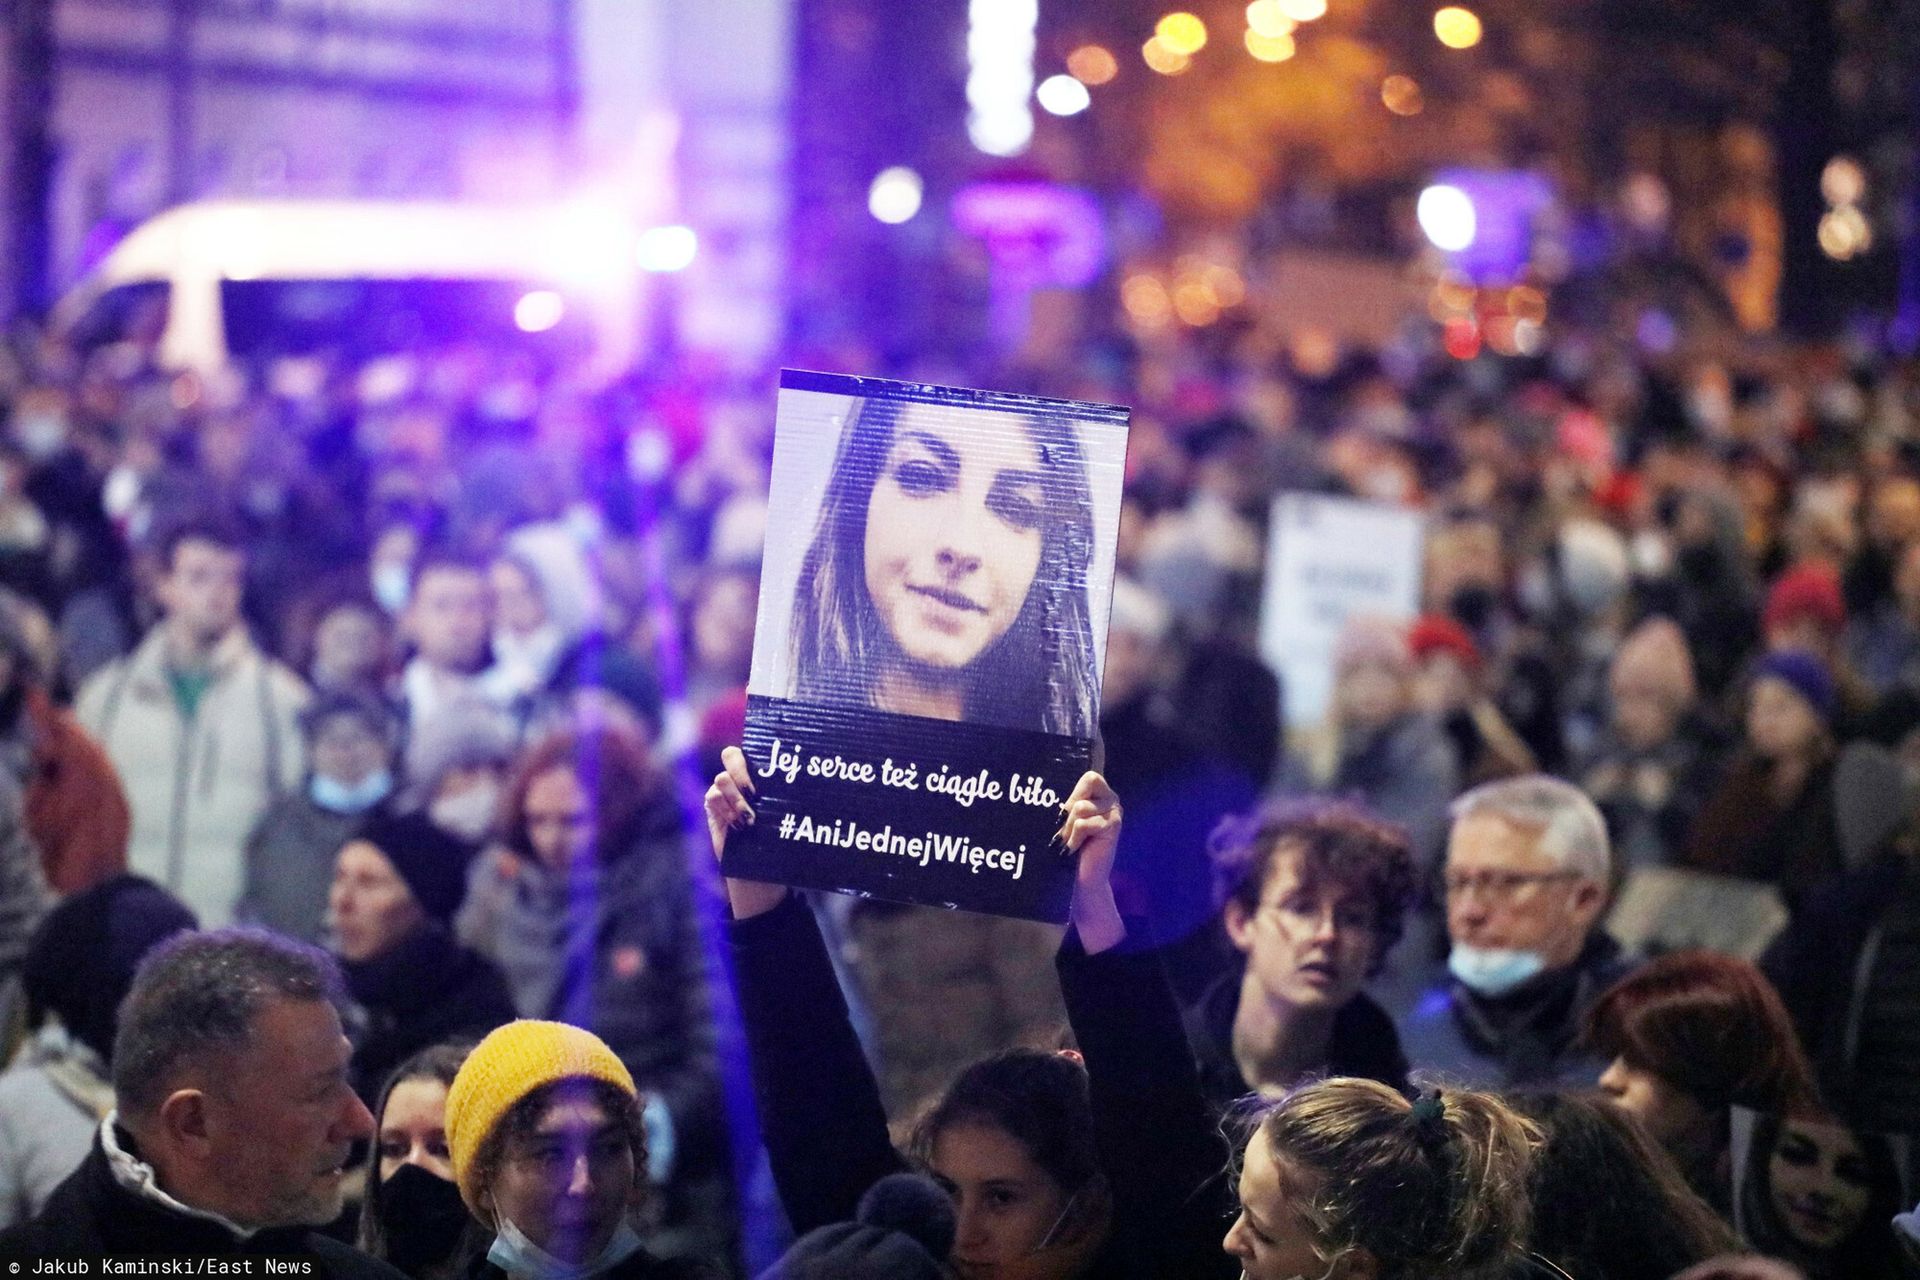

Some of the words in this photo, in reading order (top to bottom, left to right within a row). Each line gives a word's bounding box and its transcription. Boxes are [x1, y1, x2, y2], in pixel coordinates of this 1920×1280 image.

[758, 739, 802, 784] Jej
[806, 755, 876, 783] serce
[881, 758, 919, 790] też
[925, 765, 1004, 807] ciągle
[779, 813, 1026, 880] #AniJednejWięcej
